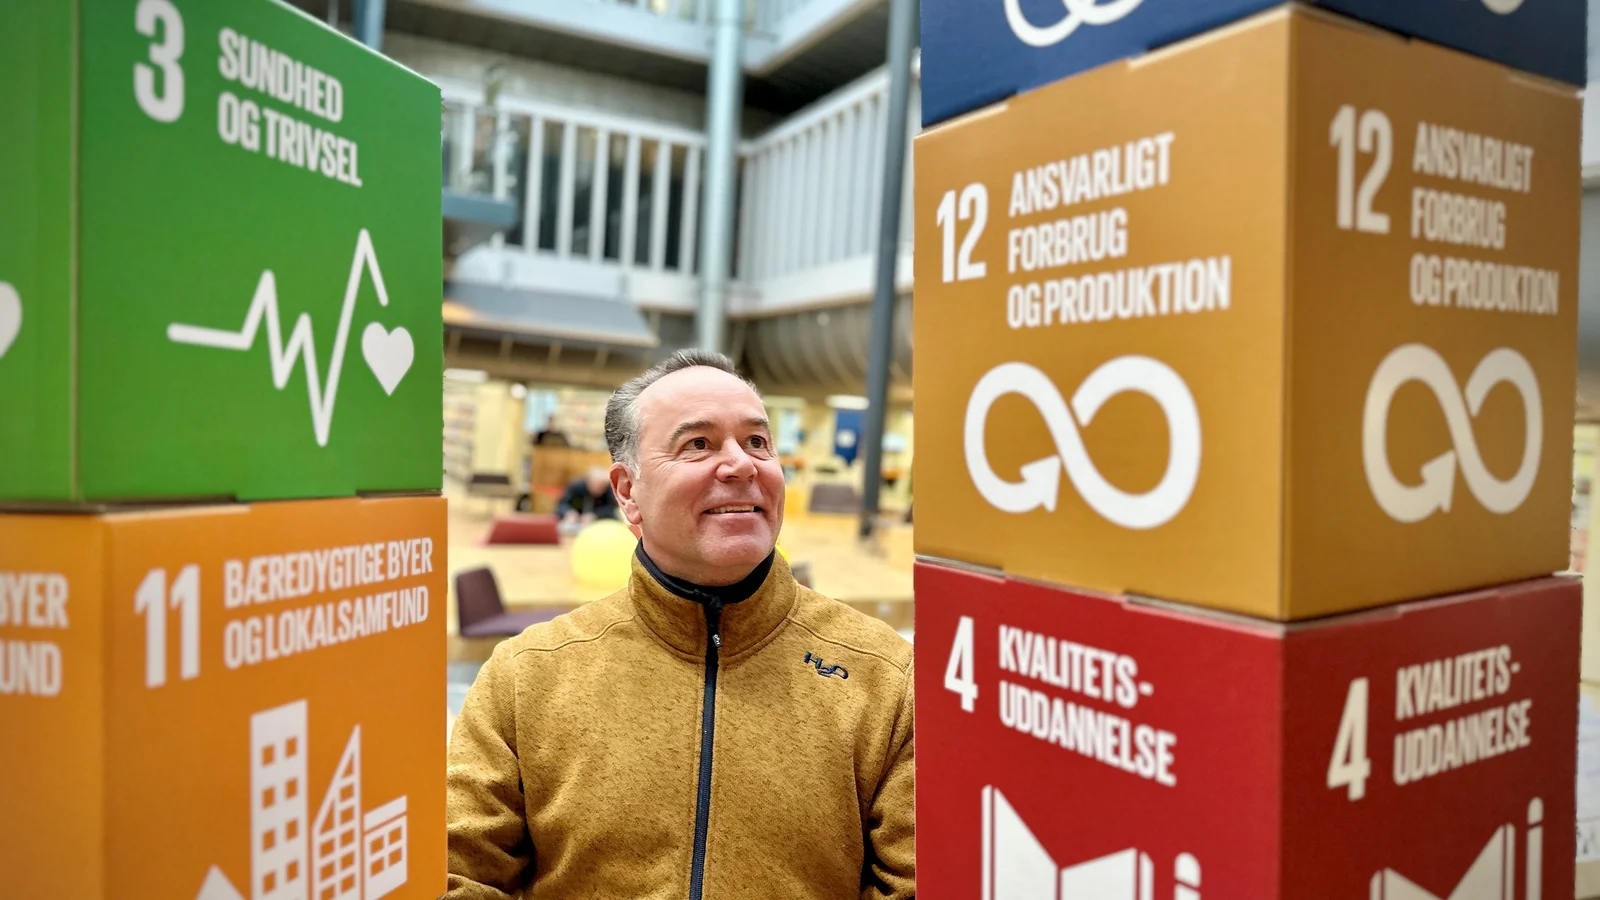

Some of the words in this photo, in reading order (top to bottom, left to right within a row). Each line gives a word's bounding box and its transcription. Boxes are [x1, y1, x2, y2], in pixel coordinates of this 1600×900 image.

[134, 0, 185, 123] 3
[218, 28, 343, 123] SUNDHED
[217, 92, 261, 151] OG
[263, 108, 362, 188] TRIVSEL
[1008, 131, 1176, 218] ANSVARLIGT
[1329, 104, 1393, 234] 12
[1413, 121, 1534, 193] ANSVARLIGT
[937, 182, 989, 283] 12
[1008, 207, 1128, 274] FORBRUG
[1410, 187, 1506, 249] FORBRUG
[1007, 282, 1041, 330] OG
[1043, 255, 1231, 326] PRODUKTION
[1409, 252, 1442, 306] OG
[1443, 256, 1560, 316] PRODUKTION
[224, 543, 385, 609] BÆREDYGTIGE
[388, 537, 434, 581] BYER
[134, 564, 201, 689] 11
[224, 615, 263, 670] OG
[265, 586, 430, 661] LOKALSAMFUND
[944, 615, 978, 713] 4
[999, 624, 1154, 709] KVALITETS-
[1395, 644, 1521, 721] KVALITETS-
[999, 680, 1177, 787] UDDANNELSE
[1327, 676, 1371, 801] 4
[1393, 699, 1532, 786] UDDANNELSE
